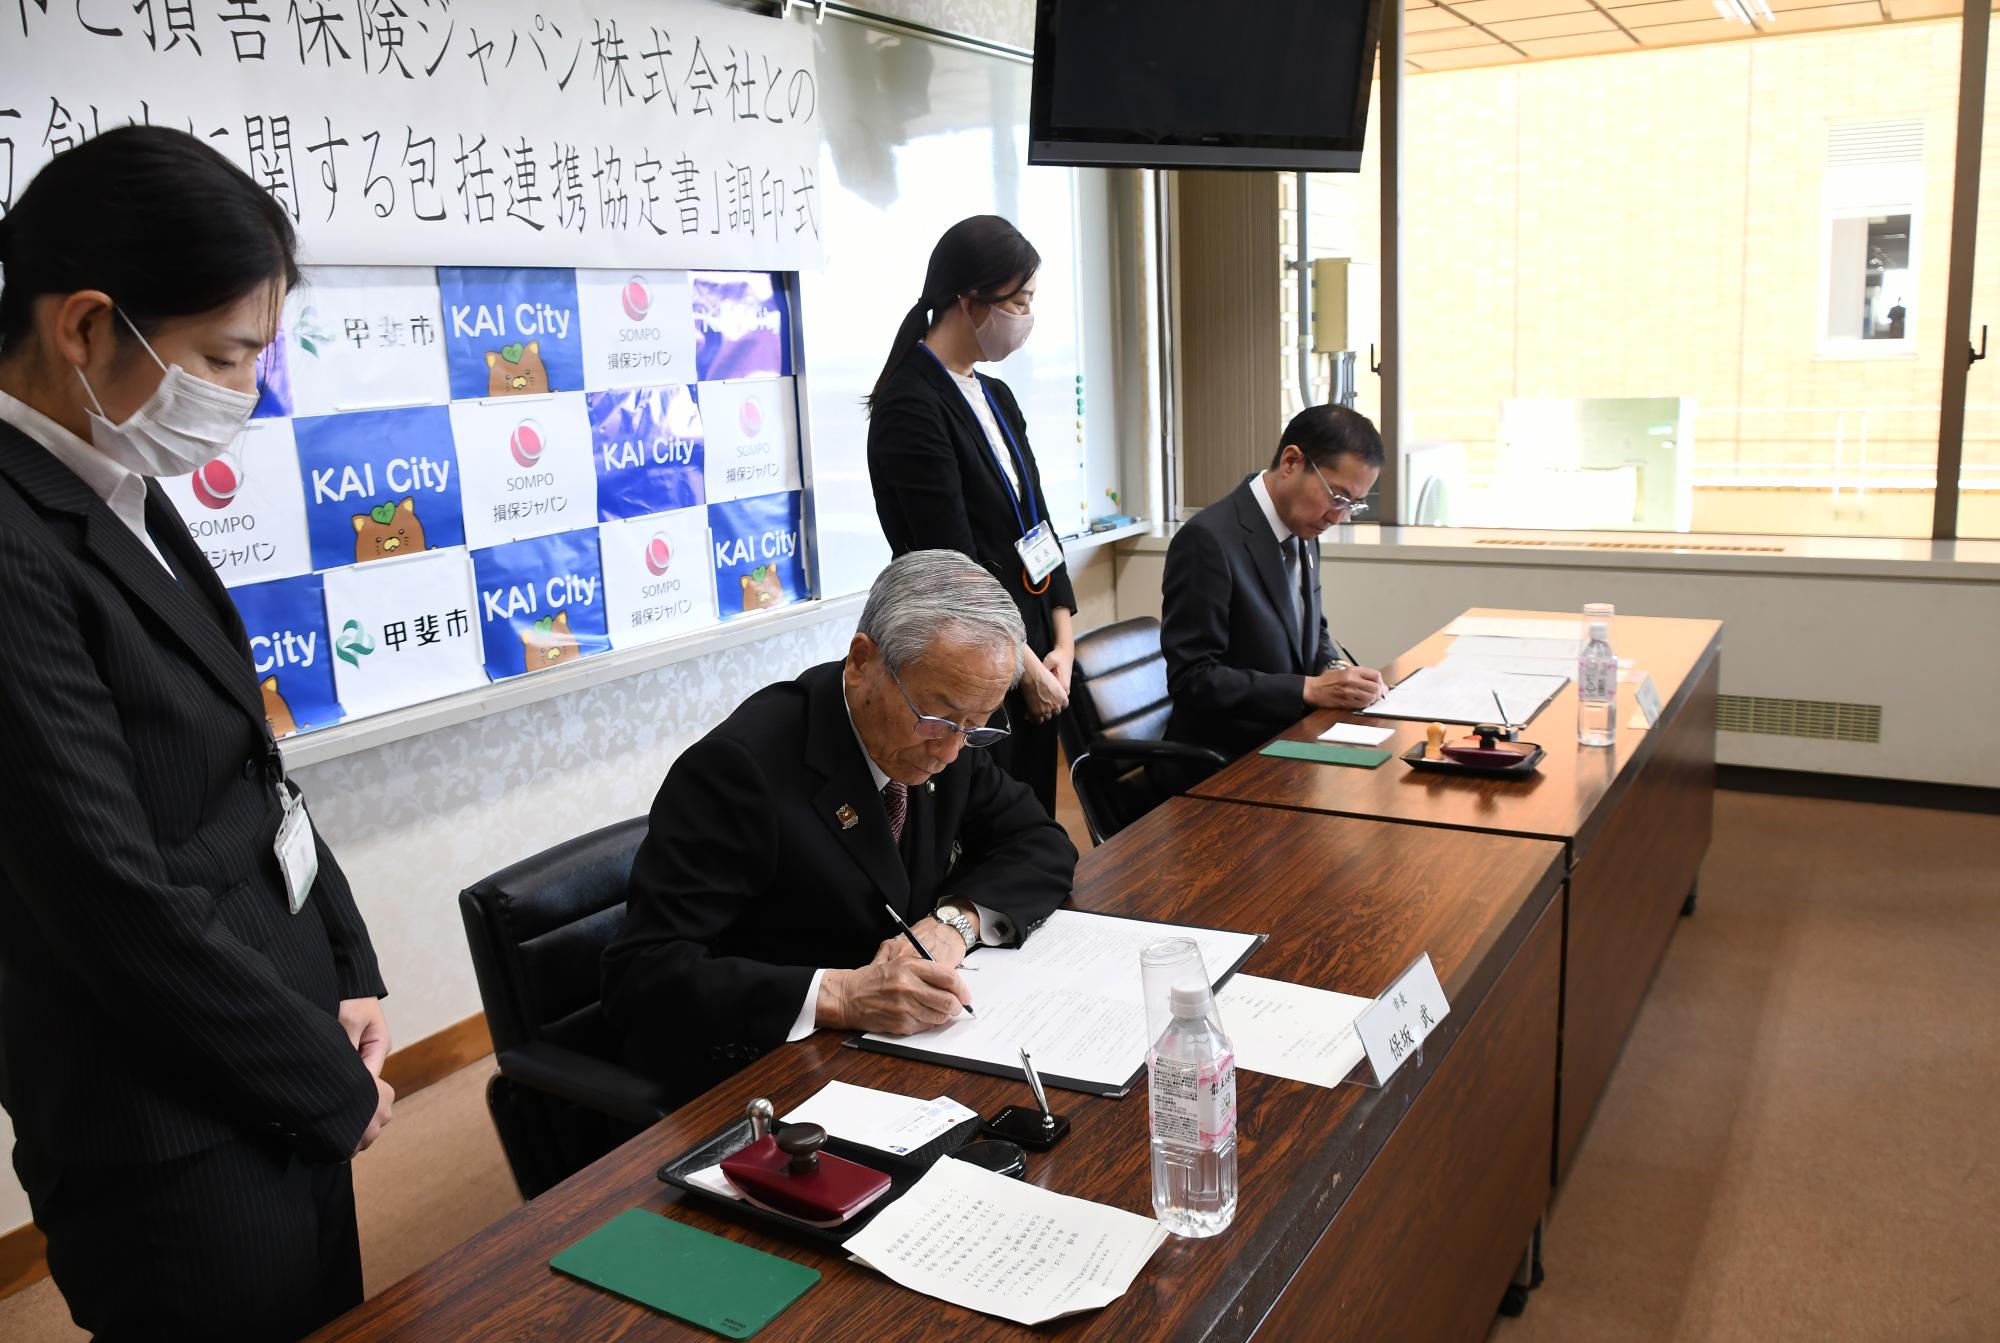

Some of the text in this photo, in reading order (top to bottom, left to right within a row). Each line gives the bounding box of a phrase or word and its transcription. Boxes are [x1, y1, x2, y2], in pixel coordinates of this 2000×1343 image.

[343, 314, 434, 349] 甲斐市
[451, 302, 570, 339] KAI City
[619, 328, 661, 342] SOMPO
[607, 350, 672, 370] 損保ジャパン
[602, 436, 695, 471] KAI City
[736, 442, 770, 458] SOMPO
[311, 456, 450, 504] KAI City
[506, 472, 554, 492] SOMPO
[725, 463, 780, 484] 損保ジャパン
[493, 496, 568, 523] 損保ジャパン
[189, 514, 255, 539] SOMPO
[203, 542, 276, 569] ジャパン
[715, 529, 797, 569] KAI City
[483, 574, 596, 622] KAI City
[641, 579, 681, 599] SOMPO
[631, 599, 693, 628] 損保ジャパン
[383, 608, 469, 652] 甲斐市
[249, 630, 317, 674] City
